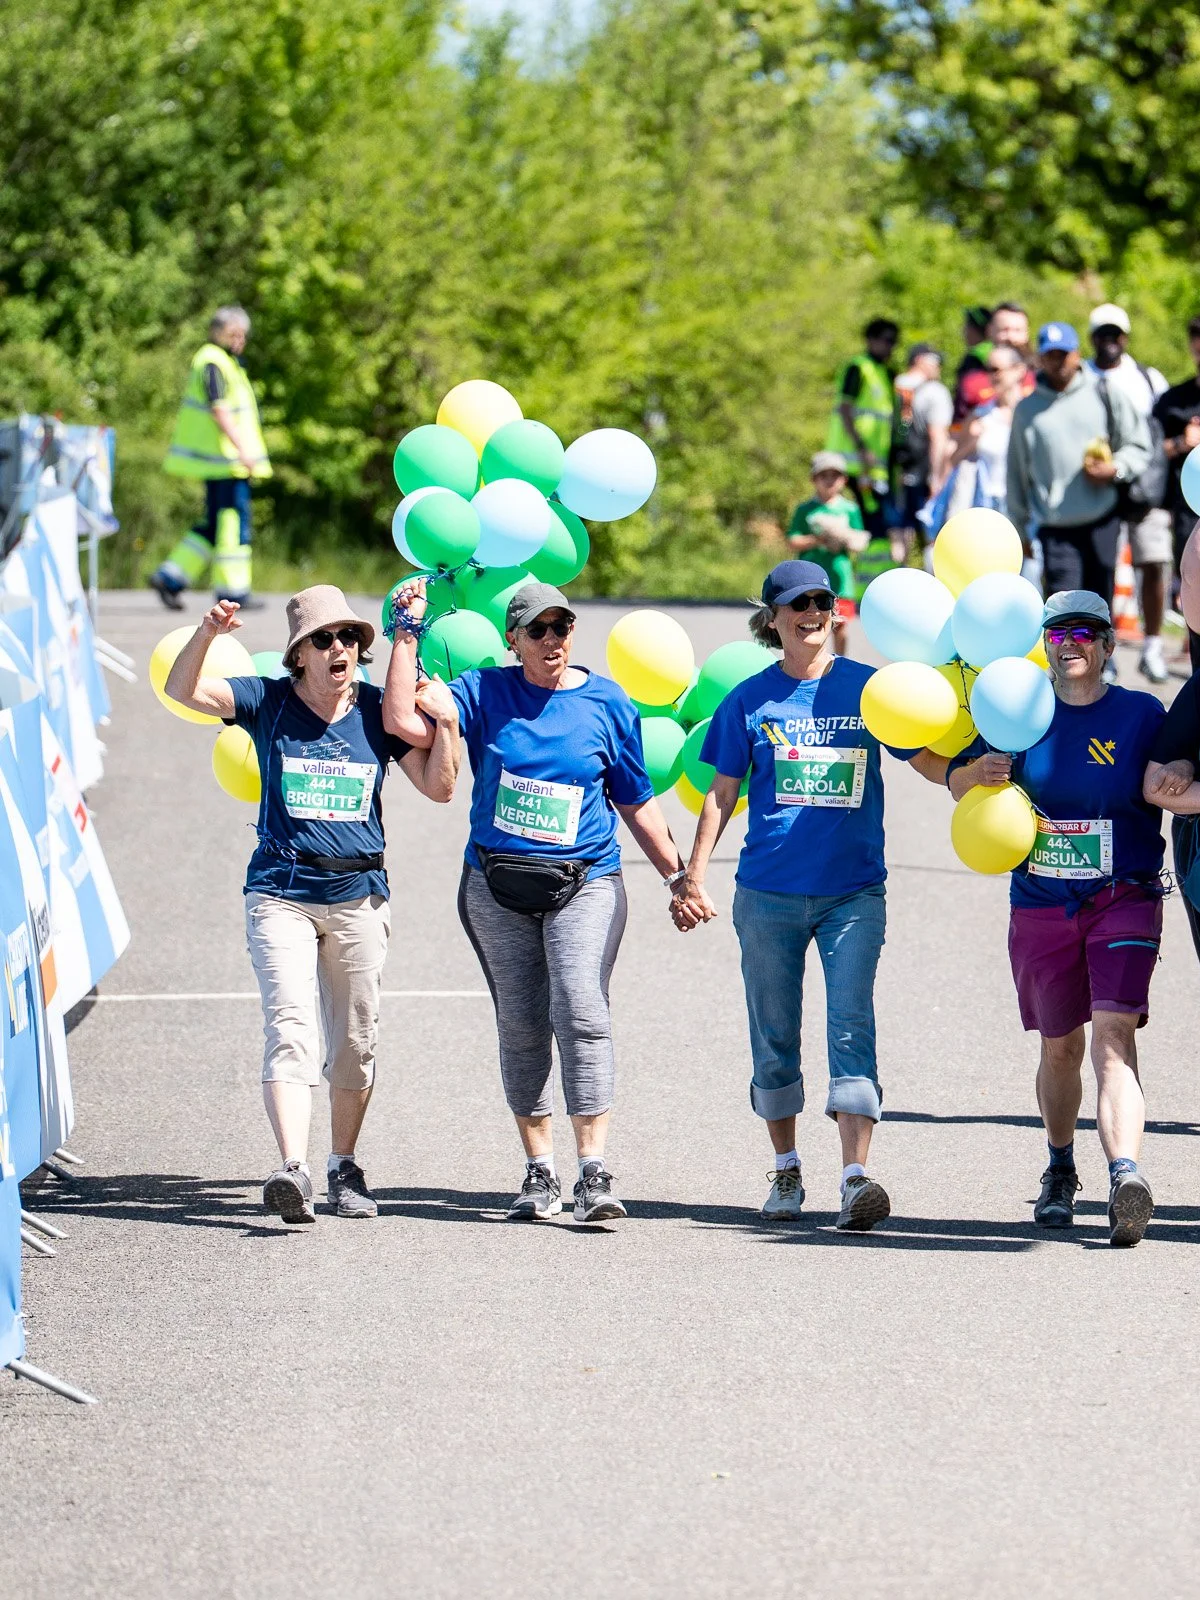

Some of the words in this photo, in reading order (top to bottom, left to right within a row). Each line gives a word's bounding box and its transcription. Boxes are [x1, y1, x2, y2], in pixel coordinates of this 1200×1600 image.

[796, 731, 836, 746] LOUF
[303, 762, 347, 775] valiant
[802, 763, 828, 776] 443
[309, 777, 336, 791] 444
[512, 780, 554, 797] valiant
[782, 778, 848, 794] CAROLA
[286, 790, 357, 808] BRIGITTE
[517, 795, 542, 810] 441
[824, 797, 847, 805] valiant
[501, 803, 560, 830] VERENA
[1047, 837, 1072, 850] 442
[1034, 849, 1092, 866] URSULA
